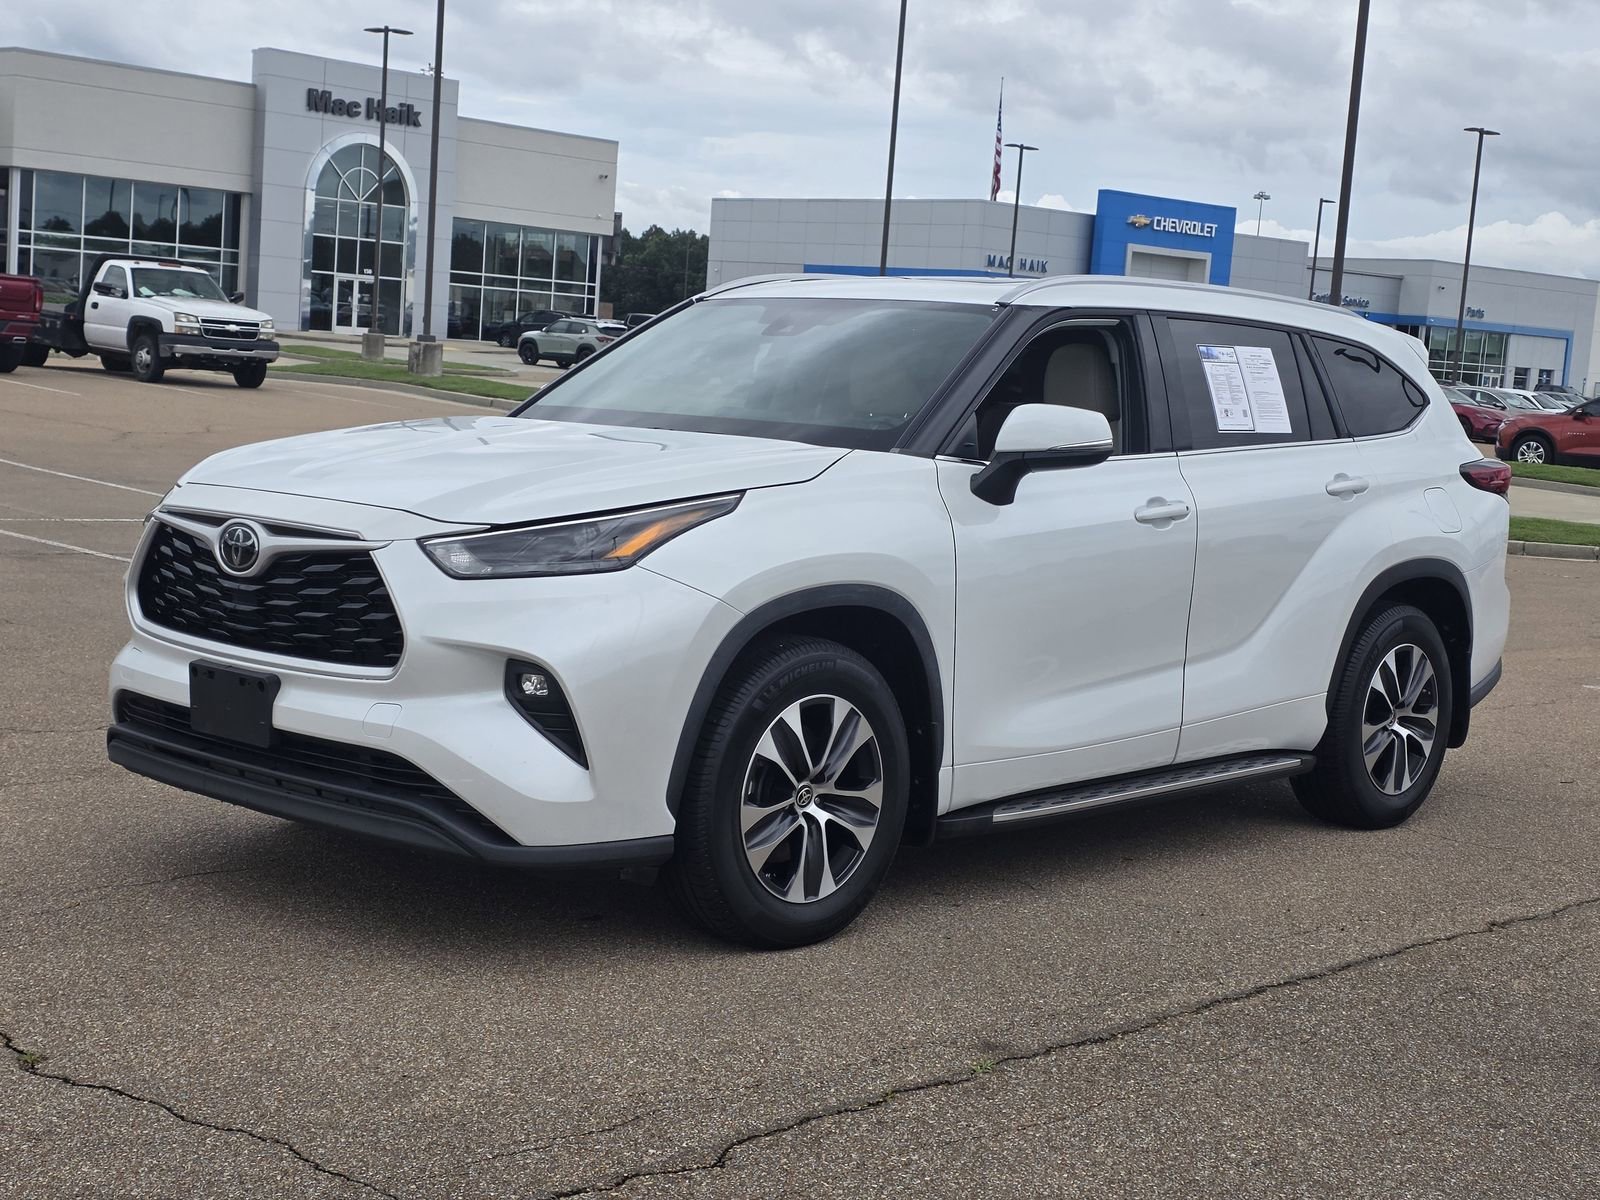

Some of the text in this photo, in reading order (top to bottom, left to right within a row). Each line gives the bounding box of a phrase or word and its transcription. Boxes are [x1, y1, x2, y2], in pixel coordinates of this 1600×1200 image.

[307, 88, 421, 127] Mac Haik
[1153, 216, 1218, 238] CHEVROLET
[1019, 257, 1048, 273] HAIK
